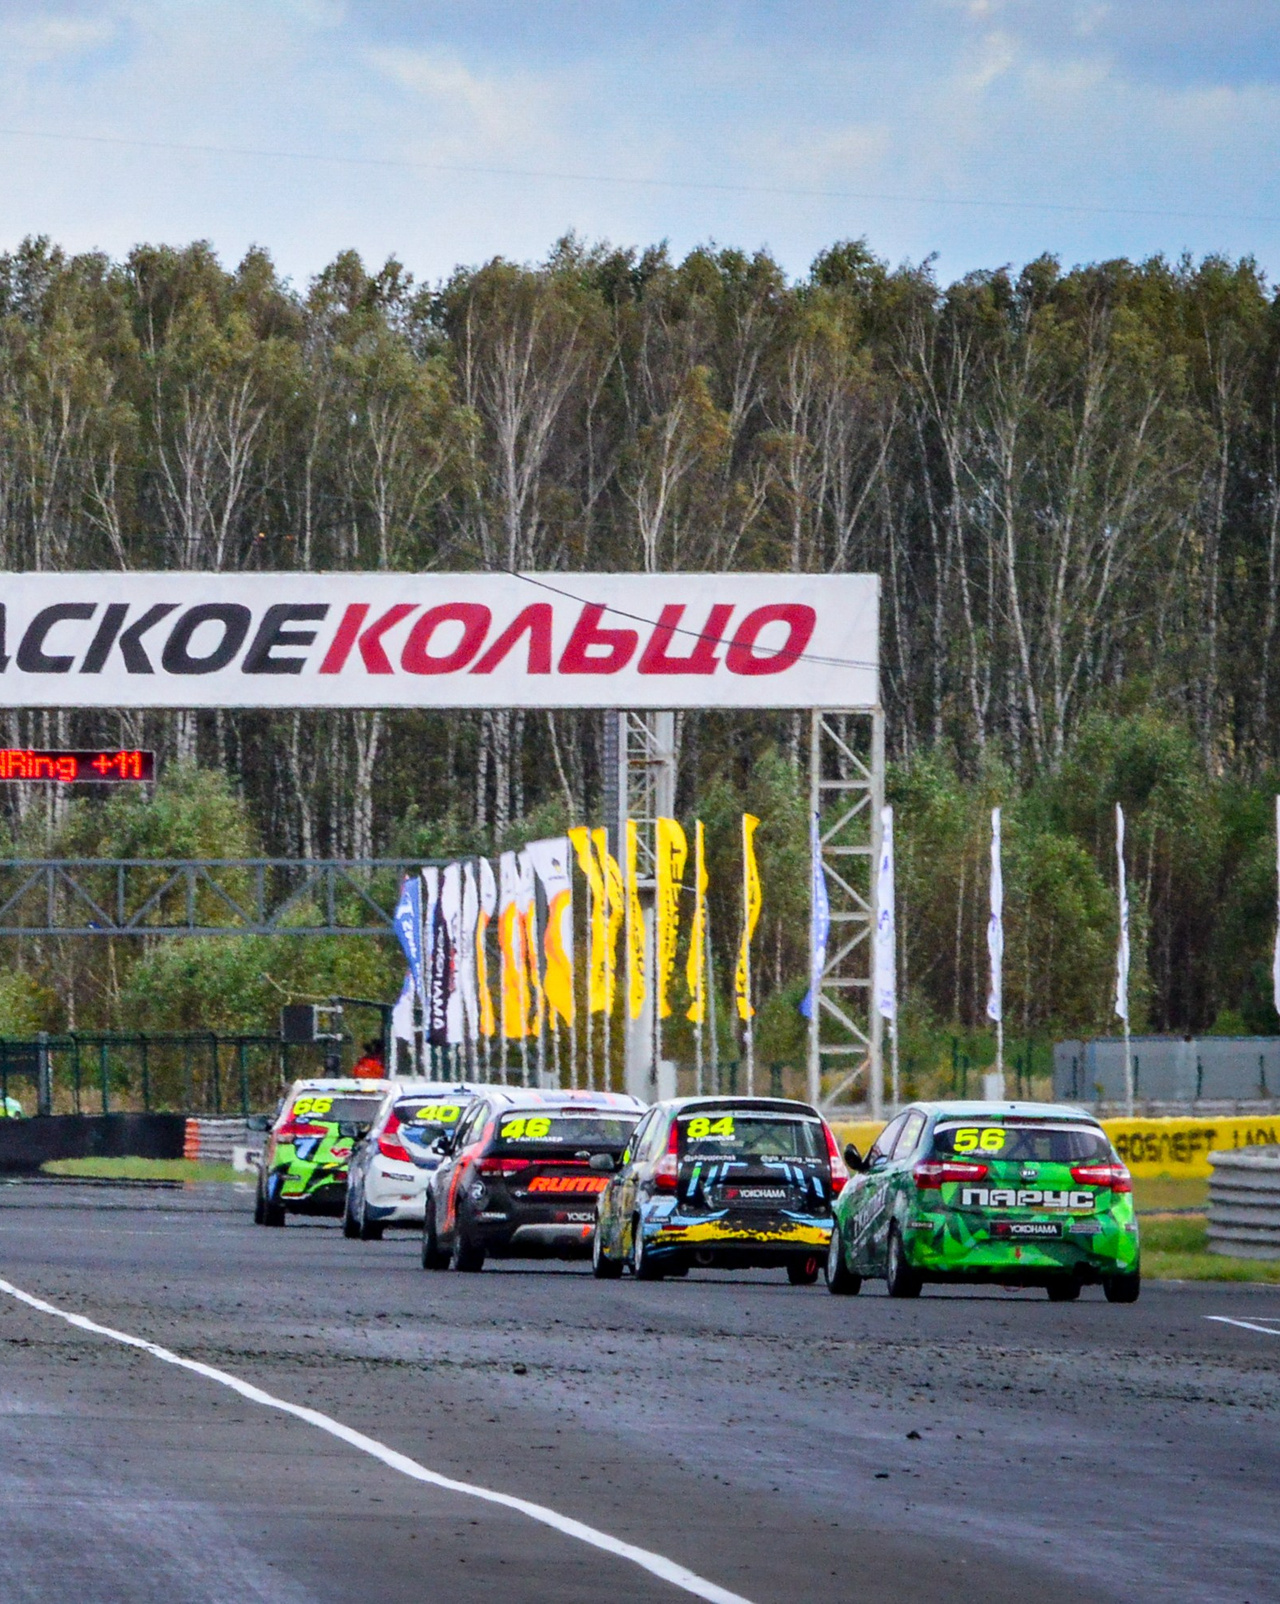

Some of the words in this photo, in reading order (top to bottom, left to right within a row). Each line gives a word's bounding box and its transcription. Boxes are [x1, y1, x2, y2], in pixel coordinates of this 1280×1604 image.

[91, 750, 143, 779] +11
[293, 1097, 334, 1115] 66
[416, 1104, 460, 1122] 40
[500, 1117, 551, 1138] 46
[687, 1116, 735, 1138] 84
[953, 1128, 1007, 1152] 56
[739, 1189, 786, 1198] YOKOHAMA
[961, 1188, 1095, 1208] ПАРУС
[1010, 1225, 1058, 1234] YOKOHAMA
